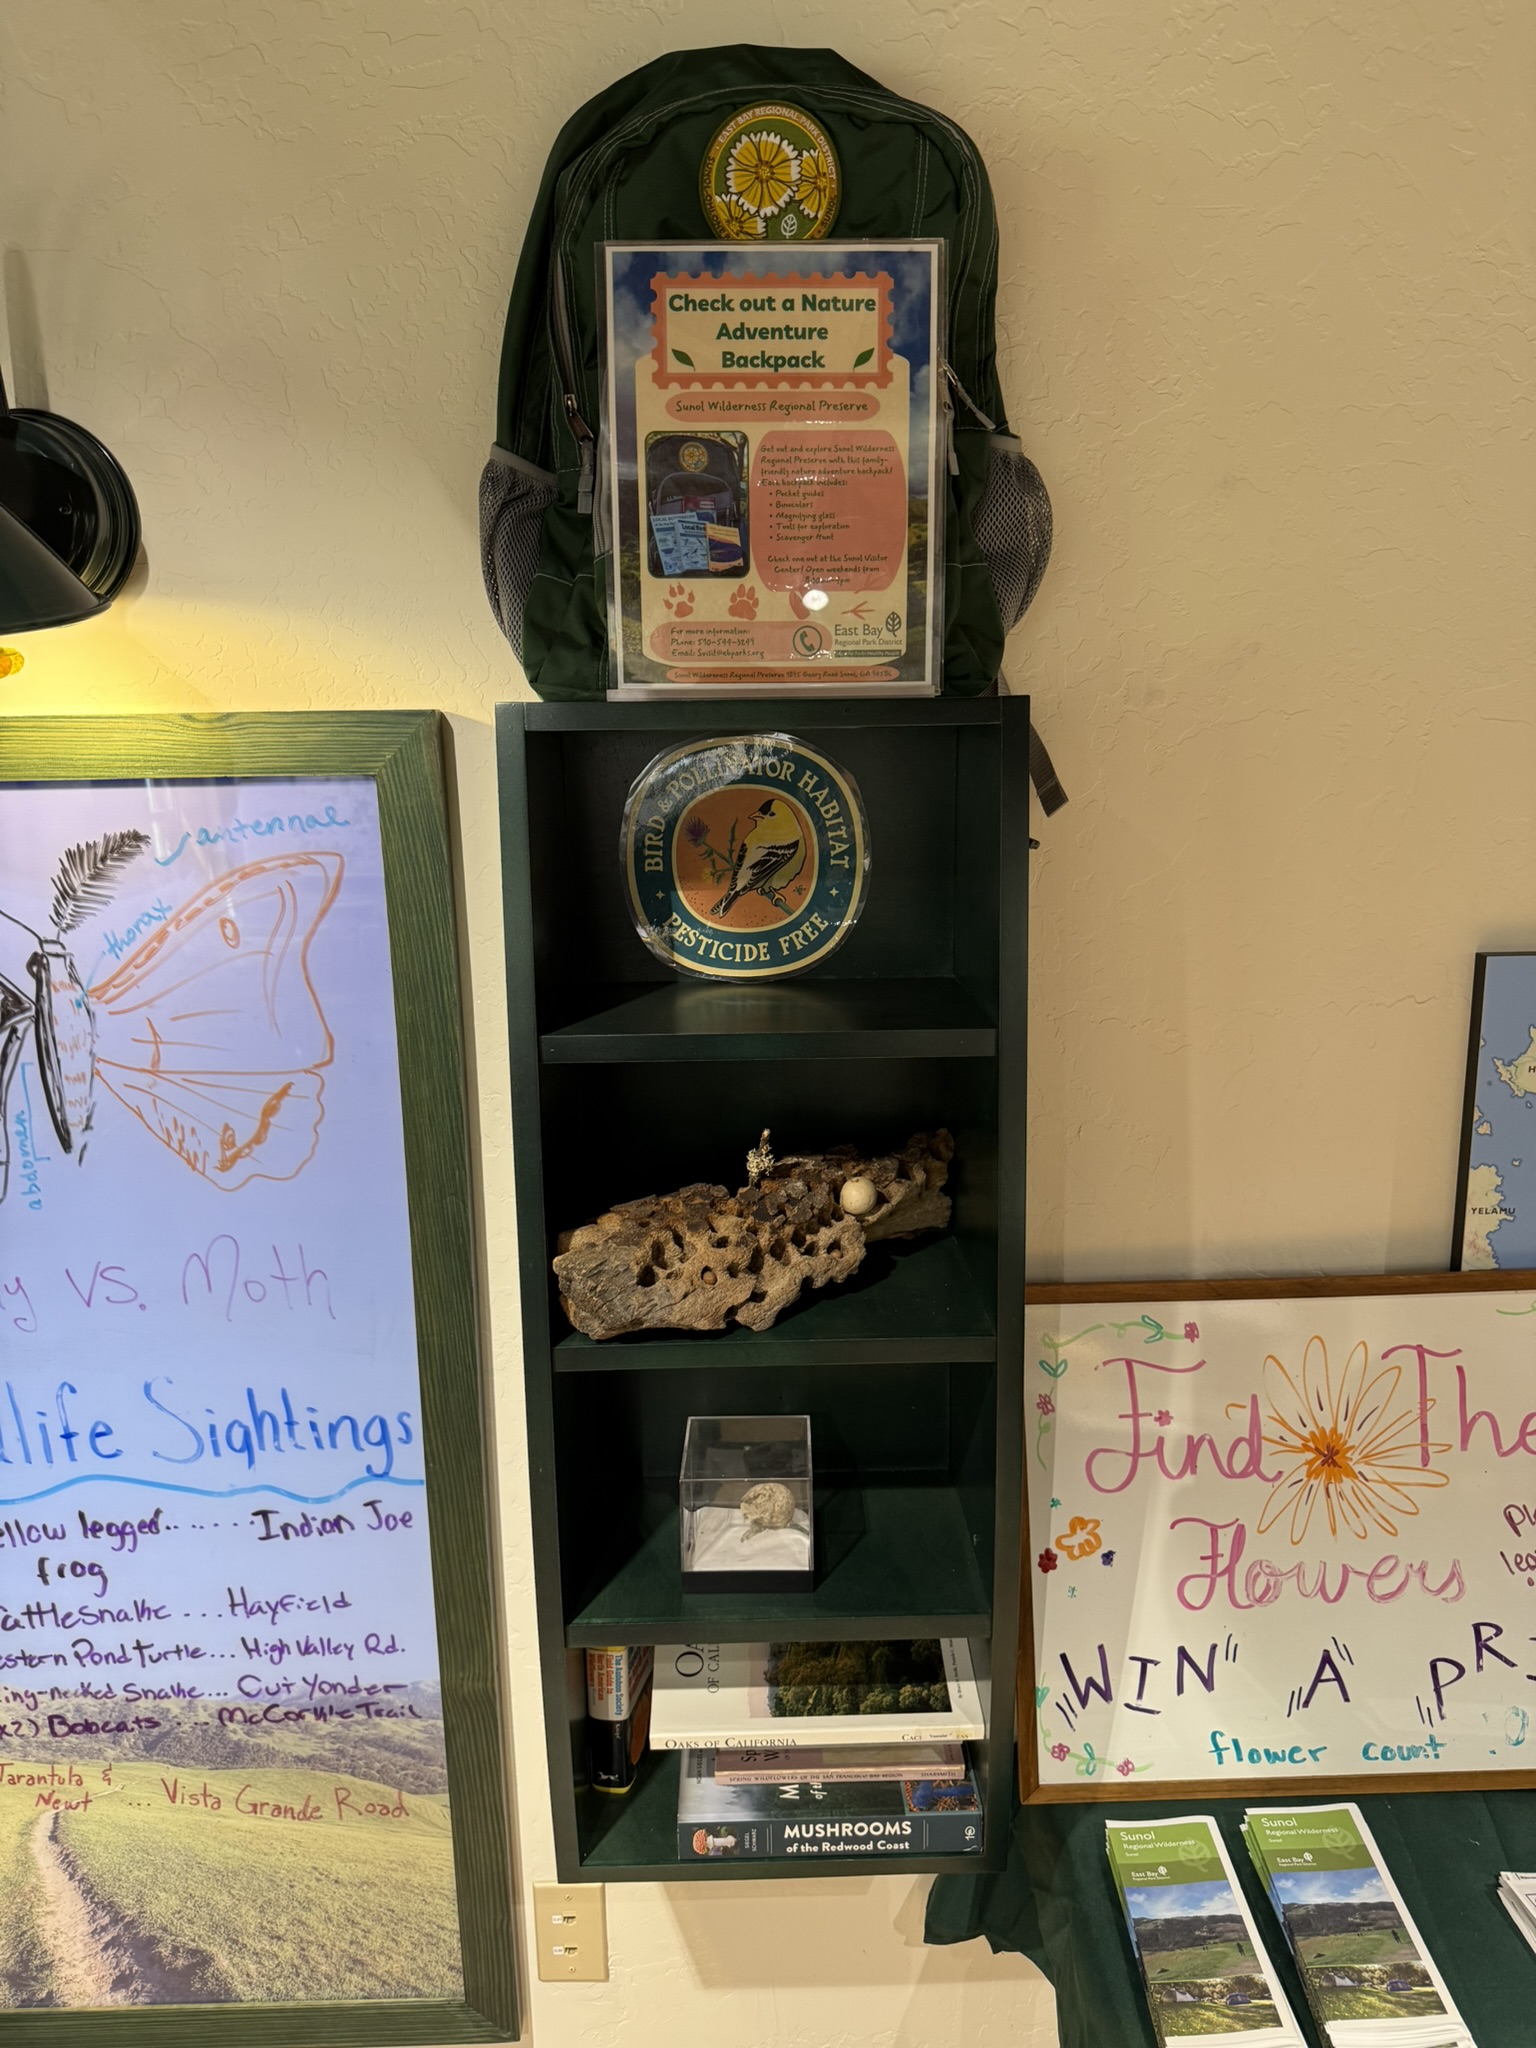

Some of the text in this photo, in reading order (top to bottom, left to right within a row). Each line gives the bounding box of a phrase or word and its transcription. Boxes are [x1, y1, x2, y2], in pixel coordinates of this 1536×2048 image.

[719, 105, 837, 180] EAST BAY REGIONAL PARK DISTRICT
[668, 293, 876, 312] Check out a Nature
[715, 321, 829, 340] Adventure
[722, 350, 825, 373] Backpack
[675, 400, 868, 416] Sunol Wilderness Regional Preserve
[760, 445, 774, 453] Get
[790, 445, 803, 453] and
[805, 445, 832, 456] explore
[834, 444, 853, 453] Sunol
[855, 444, 895, 453] Wilderness
[760, 456, 792, 467] Regional
[794, 456, 826, 465] Preserve
[829, 456, 845, 464] with
[847, 456, 860, 464] this
[760, 467, 790, 478] friendly
[818, 467, 855, 475] adventure
[775, 490, 824, 500] Pocket guides
[775, 501, 813, 509] Binoculars
[775, 512, 835, 522] Magnifying glass
[776, 522, 850, 533] Tools for exploration
[776, 533, 834, 543] Scavenger Hunt
[768, 554, 790, 562] Check
[830, 554, 841, 562] the
[843, 554, 862, 562] Sunol
[864, 554, 888, 562] Visitor
[805, 566, 824, 575] Open
[826, 565, 861, 573] weekends
[863, 565, 879, 574] from
[671, 626, 683, 635] For
[706, 627, 750, 636] information:
[834, 624, 883, 639] East Bay
[671, 637, 695, 646] Phone:
[834, 639, 860, 647] Regional
[878, 638, 902, 646] District
[672, 648, 695, 657] Email:
[729, 671, 756, 680] Regional
[644, 756, 851, 873] BIRD & POLLINATOR HABITAT
[103, 897, 173, 960] thorax
[662, 912, 829, 962] PESTICIDE FREE
[15, 1110, 43, 1211] abdomen
[1471, 1207, 1516, 1215] YELAMU
[181, 1233, 338, 1322] Moth
[143, 1376, 413, 1478] Sightings
[1085, 1358, 1284, 1493] Find
[252, 1510, 355, 1541] Indian
[363, 1500, 414, 1532] Joe
[1169, 1518, 1467, 1612] Flowers
[37, 1556, 109, 1598] frog
[71, 1638, 132, 1667] Pond
[240, 1636, 292, 1665] High
[296, 1635, 354, 1661] Valley
[365, 1633, 406, 1655] Rd.
[302, 1673, 408, 1700] Yonder
[615, 1667, 623, 1693] Audubon
[614, 1693, 624, 1716] Society
[47, 1714, 162, 1738] Bobcats
[355, 1701, 423, 1720] Trail
[1209, 1730, 1448, 1766] flower count
[35, 1777, 410, 1821] Newt Vista Grande Road
[784, 1820, 912, 1838] MUSHROOMS
[1261, 1817, 1298, 1827] Sunol
[1120, 1830, 1156, 1841] Sunol
[1265, 1827, 1339, 1837] Regional Wilderness
[786, 1839, 910, 1853] of the Redwood Coast
[1154, 1840, 1196, 1848] Wilderness
